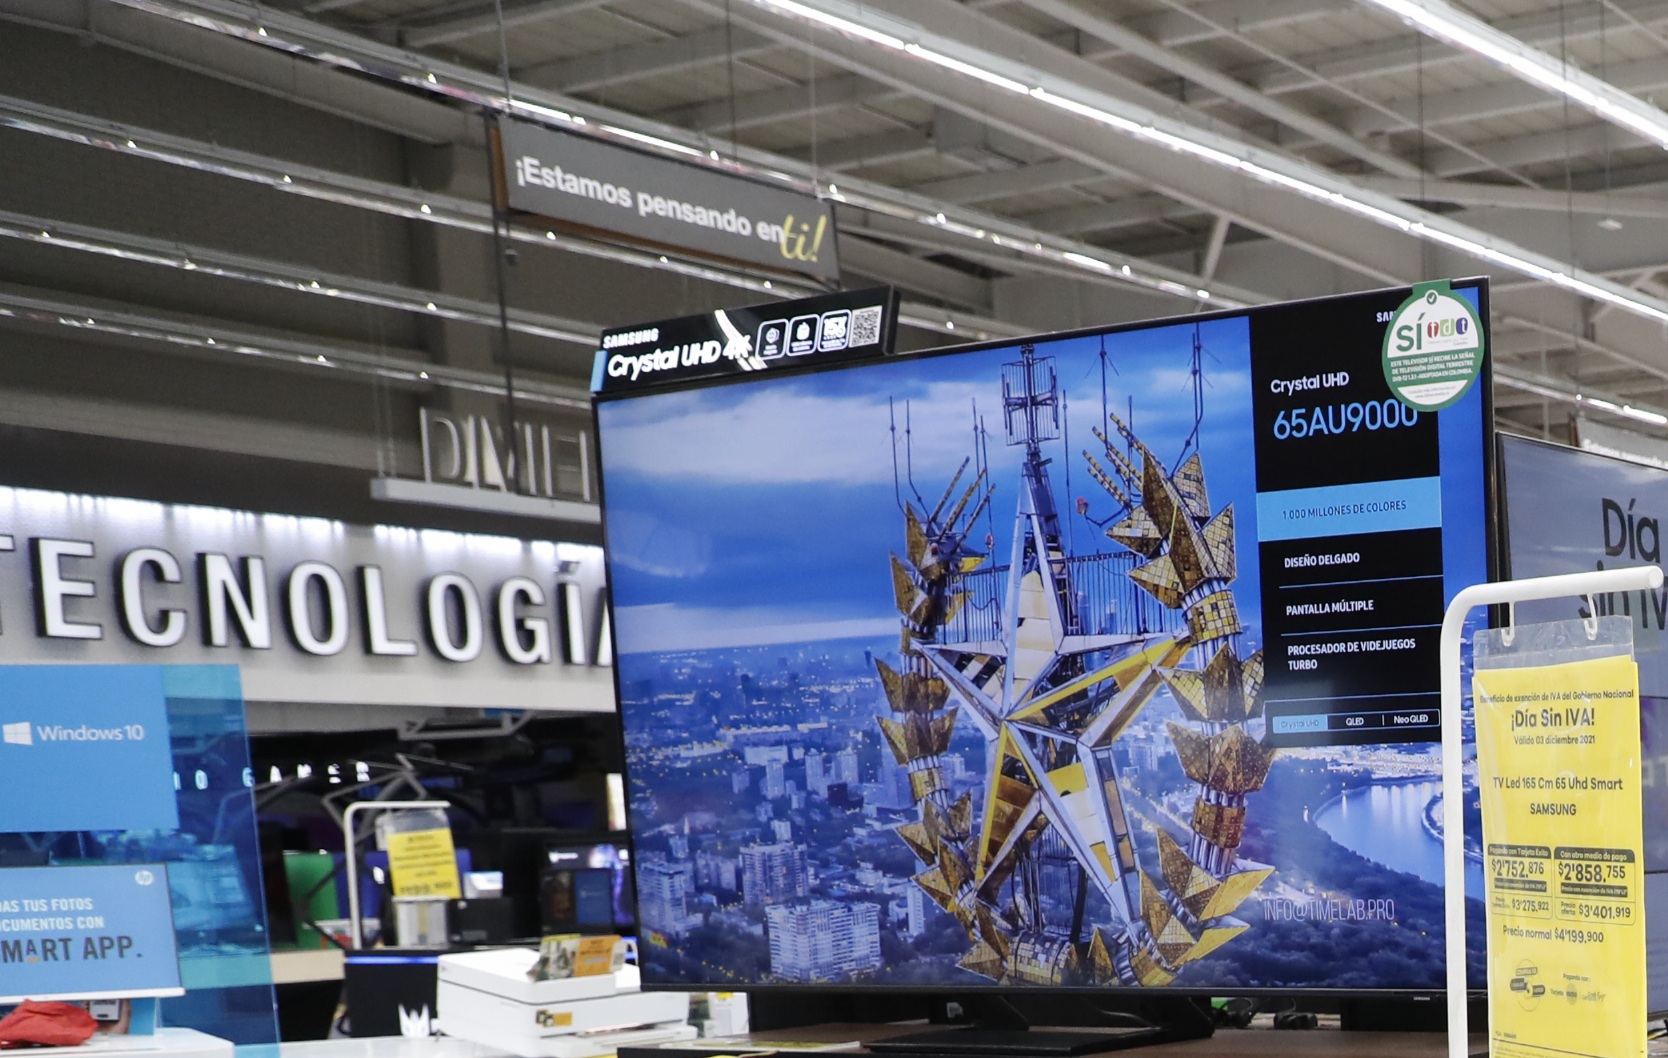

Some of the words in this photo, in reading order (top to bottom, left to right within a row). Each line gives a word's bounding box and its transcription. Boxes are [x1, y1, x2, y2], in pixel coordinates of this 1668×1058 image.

[514, 156, 633, 208] ¡Estamos
[637, 192, 752, 237] pensando
[756, 222, 784, 243] en
[780, 214, 827, 262] ti!
[603, 328, 659, 349] SAMSUNG
[1396, 312, 1426, 352] SÍ
[608, 347, 679, 381] Crystal
[680, 341, 722, 367] UHD
[1270, 373, 1320, 396] Crystal
[1323, 371, 1349, 388] UHD
[1273, 398, 1418, 439] 65AU9000
[1282, 507, 1306, 520] 1.000
[1308, 504, 1351, 519] MILLONES
[1352, 502, 1365, 514] DE
[1366, 500, 1407, 513] COLORES
[1602, 497, 1660, 563] Día
[1284, 553, 1317, 568] DISEÑO
[1318, 552, 1360, 566] DELGADO
[0, 534, 613, 668] ECNOLOGÍ
[1286, 603, 1330, 616] PANTALLA
[1331, 599, 1375, 613] MÚLTIPLE
[1287, 642, 1346, 656] PROCESADOR
[1347, 641, 1360, 652] DE
[1288, 659, 1318, 671] TURBO
[1514, 693, 1540, 702] exención
[1550, 692, 1560, 700] IVA
[1562, 692, 1572, 700] del
[1572, 690, 1602, 699] Gobierno
[1602, 689, 1634, 698] Nacional
[1345, 717, 1364, 727] QLED
[1393, 715, 1409, 725] Neo
[1511, 708, 1537, 731] ¡Día
[1541, 708, 1562, 727] Sin
[1565, 707, 1595, 726] IVA!
[37, 723, 122, 743] Windows
[123, 724, 145, 742] 10
[1514, 735, 1535, 745] Válido
[1535, 736, 1544, 745] 03
[1545, 735, 1579, 745] diciembre
[1580, 735, 1595, 744] 2021
[1493, 777, 1504, 789] TV
[1505, 777, 1521, 789] Led
[1522, 777, 1536, 789] 165
[1538, 778, 1554, 790] Cm
[1555, 778, 1566, 790] 65
[1568, 777, 1588, 790] Uhd
[1590, 778, 1623, 790] Smart
[1530, 803, 1577, 816] SAMSUNG
[1584, 852, 1602, 860] medio
[1611, 854, 1627, 862] pago
[23, 899, 48, 912] TUS
[51, 898, 94, 911] FOTOS
[1264, 898, 1395, 922] INFO@TIMELAB.PRO
[0, 916, 74, 932] CUMENTOS
[77, 916, 105, 929] CON
[1503, 925, 1524, 937] Precio
[1525, 928, 1552, 940] normal
[0, 938, 72, 963] MART
[83, 935, 142, 960] APP.
